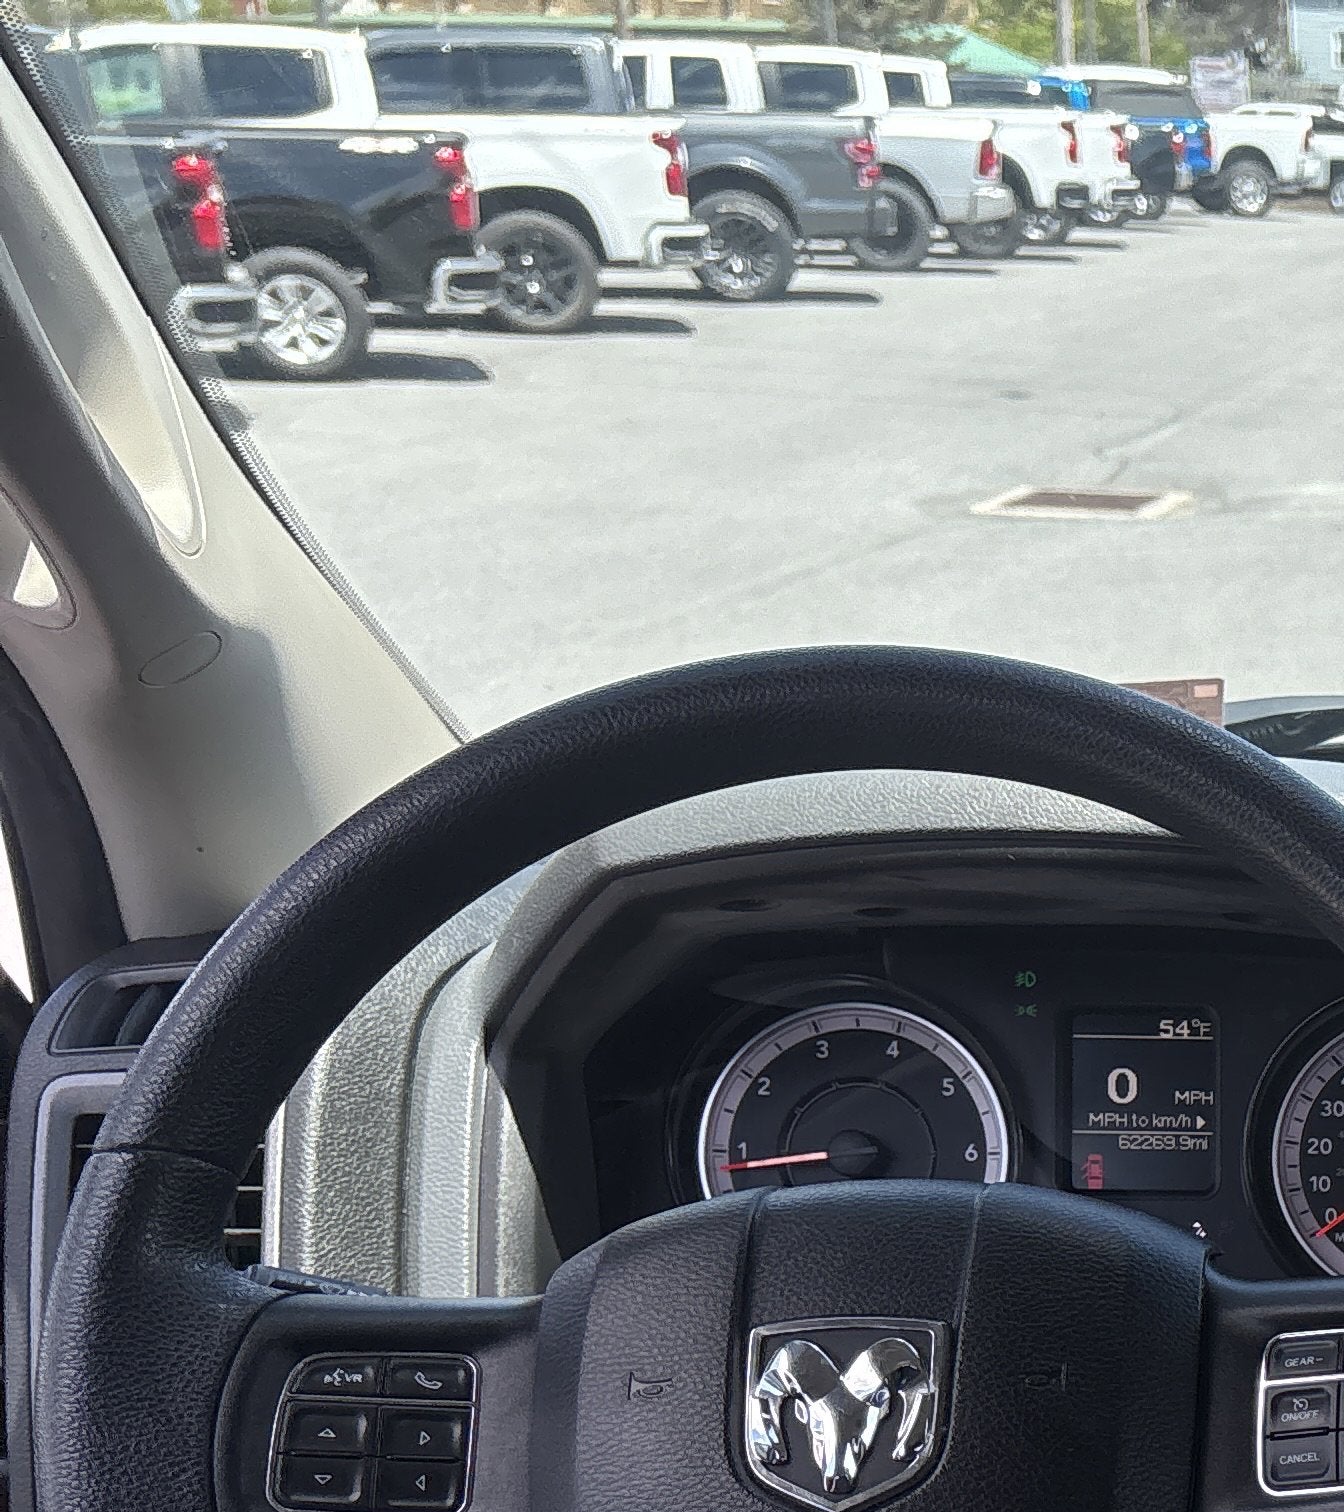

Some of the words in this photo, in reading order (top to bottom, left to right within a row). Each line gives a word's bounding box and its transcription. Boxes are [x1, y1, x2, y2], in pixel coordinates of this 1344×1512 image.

[815, 1040, 829, 1059] 3
[885, 1040, 899, 1058] 4
[757, 1077, 771, 1096] 2
[942, 1078, 955, 1097] 5
[1107, 1067, 1138, 1105] 0
[1174, 1090, 1214, 1105] MPH
[1320, 1100, 1344, 1118] 30
[1088, 1112, 1128, 1127] MPH
[1132, 1113, 1149, 1127] to
[1152, 1113, 1191, 1128] km/h
[737, 1142, 747, 1159] 1
[964, 1143, 978, 1162] 6
[1307, 1138, 1332, 1155] 20
[1309, 1176, 1331, 1193] 10
[1325, 1208, 1338, 1225] 0
[1279, 1453, 1320, 1465] CANCEL
